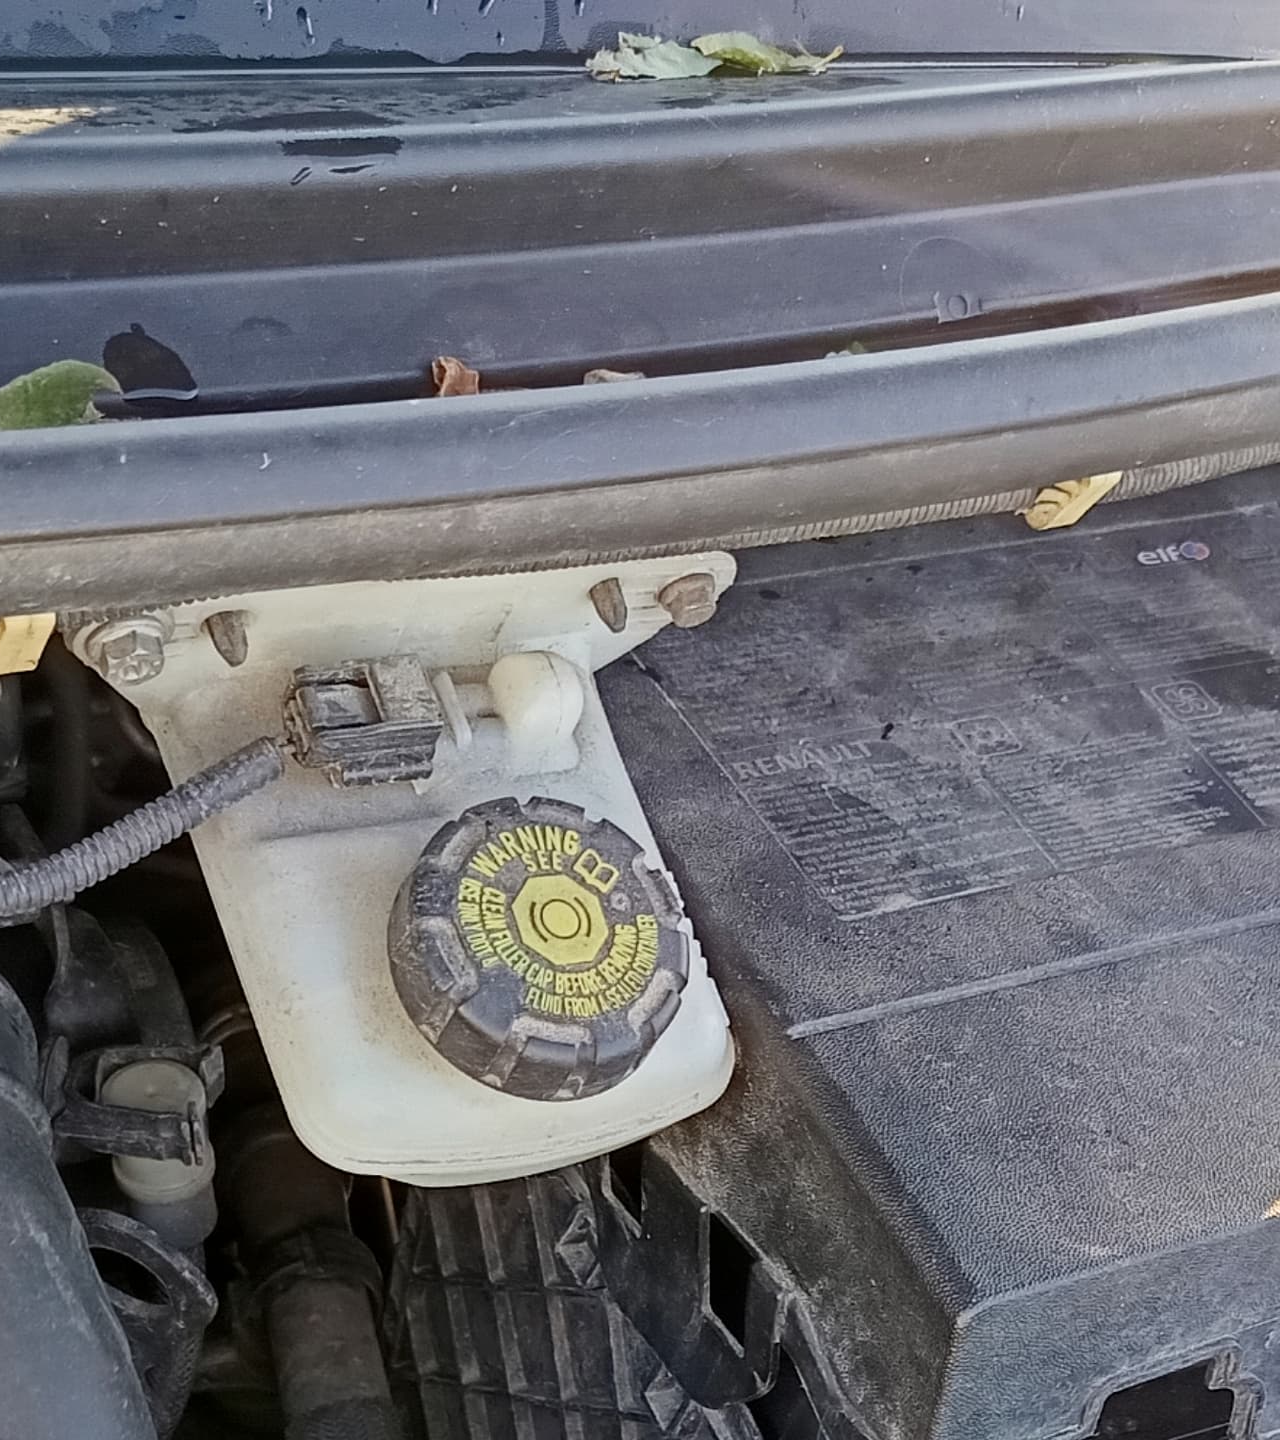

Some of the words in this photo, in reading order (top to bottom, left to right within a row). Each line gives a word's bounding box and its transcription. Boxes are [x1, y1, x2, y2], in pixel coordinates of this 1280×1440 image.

[1136, 547, 1181, 566] elf
[732, 748, 873, 781] RENAULT
[471, 826, 579, 878] WARNING
[524, 850, 563, 873] SEE
[482, 886, 507, 930] CLEAN
[459, 877, 483, 902] USE
[524, 986, 563, 1015] FLUID
[563, 995, 600, 1017] FROM
[488, 930, 531, 976] FILLER
[524, 961, 554, 989] CAP
[554, 967, 608, 995] BEFORE
